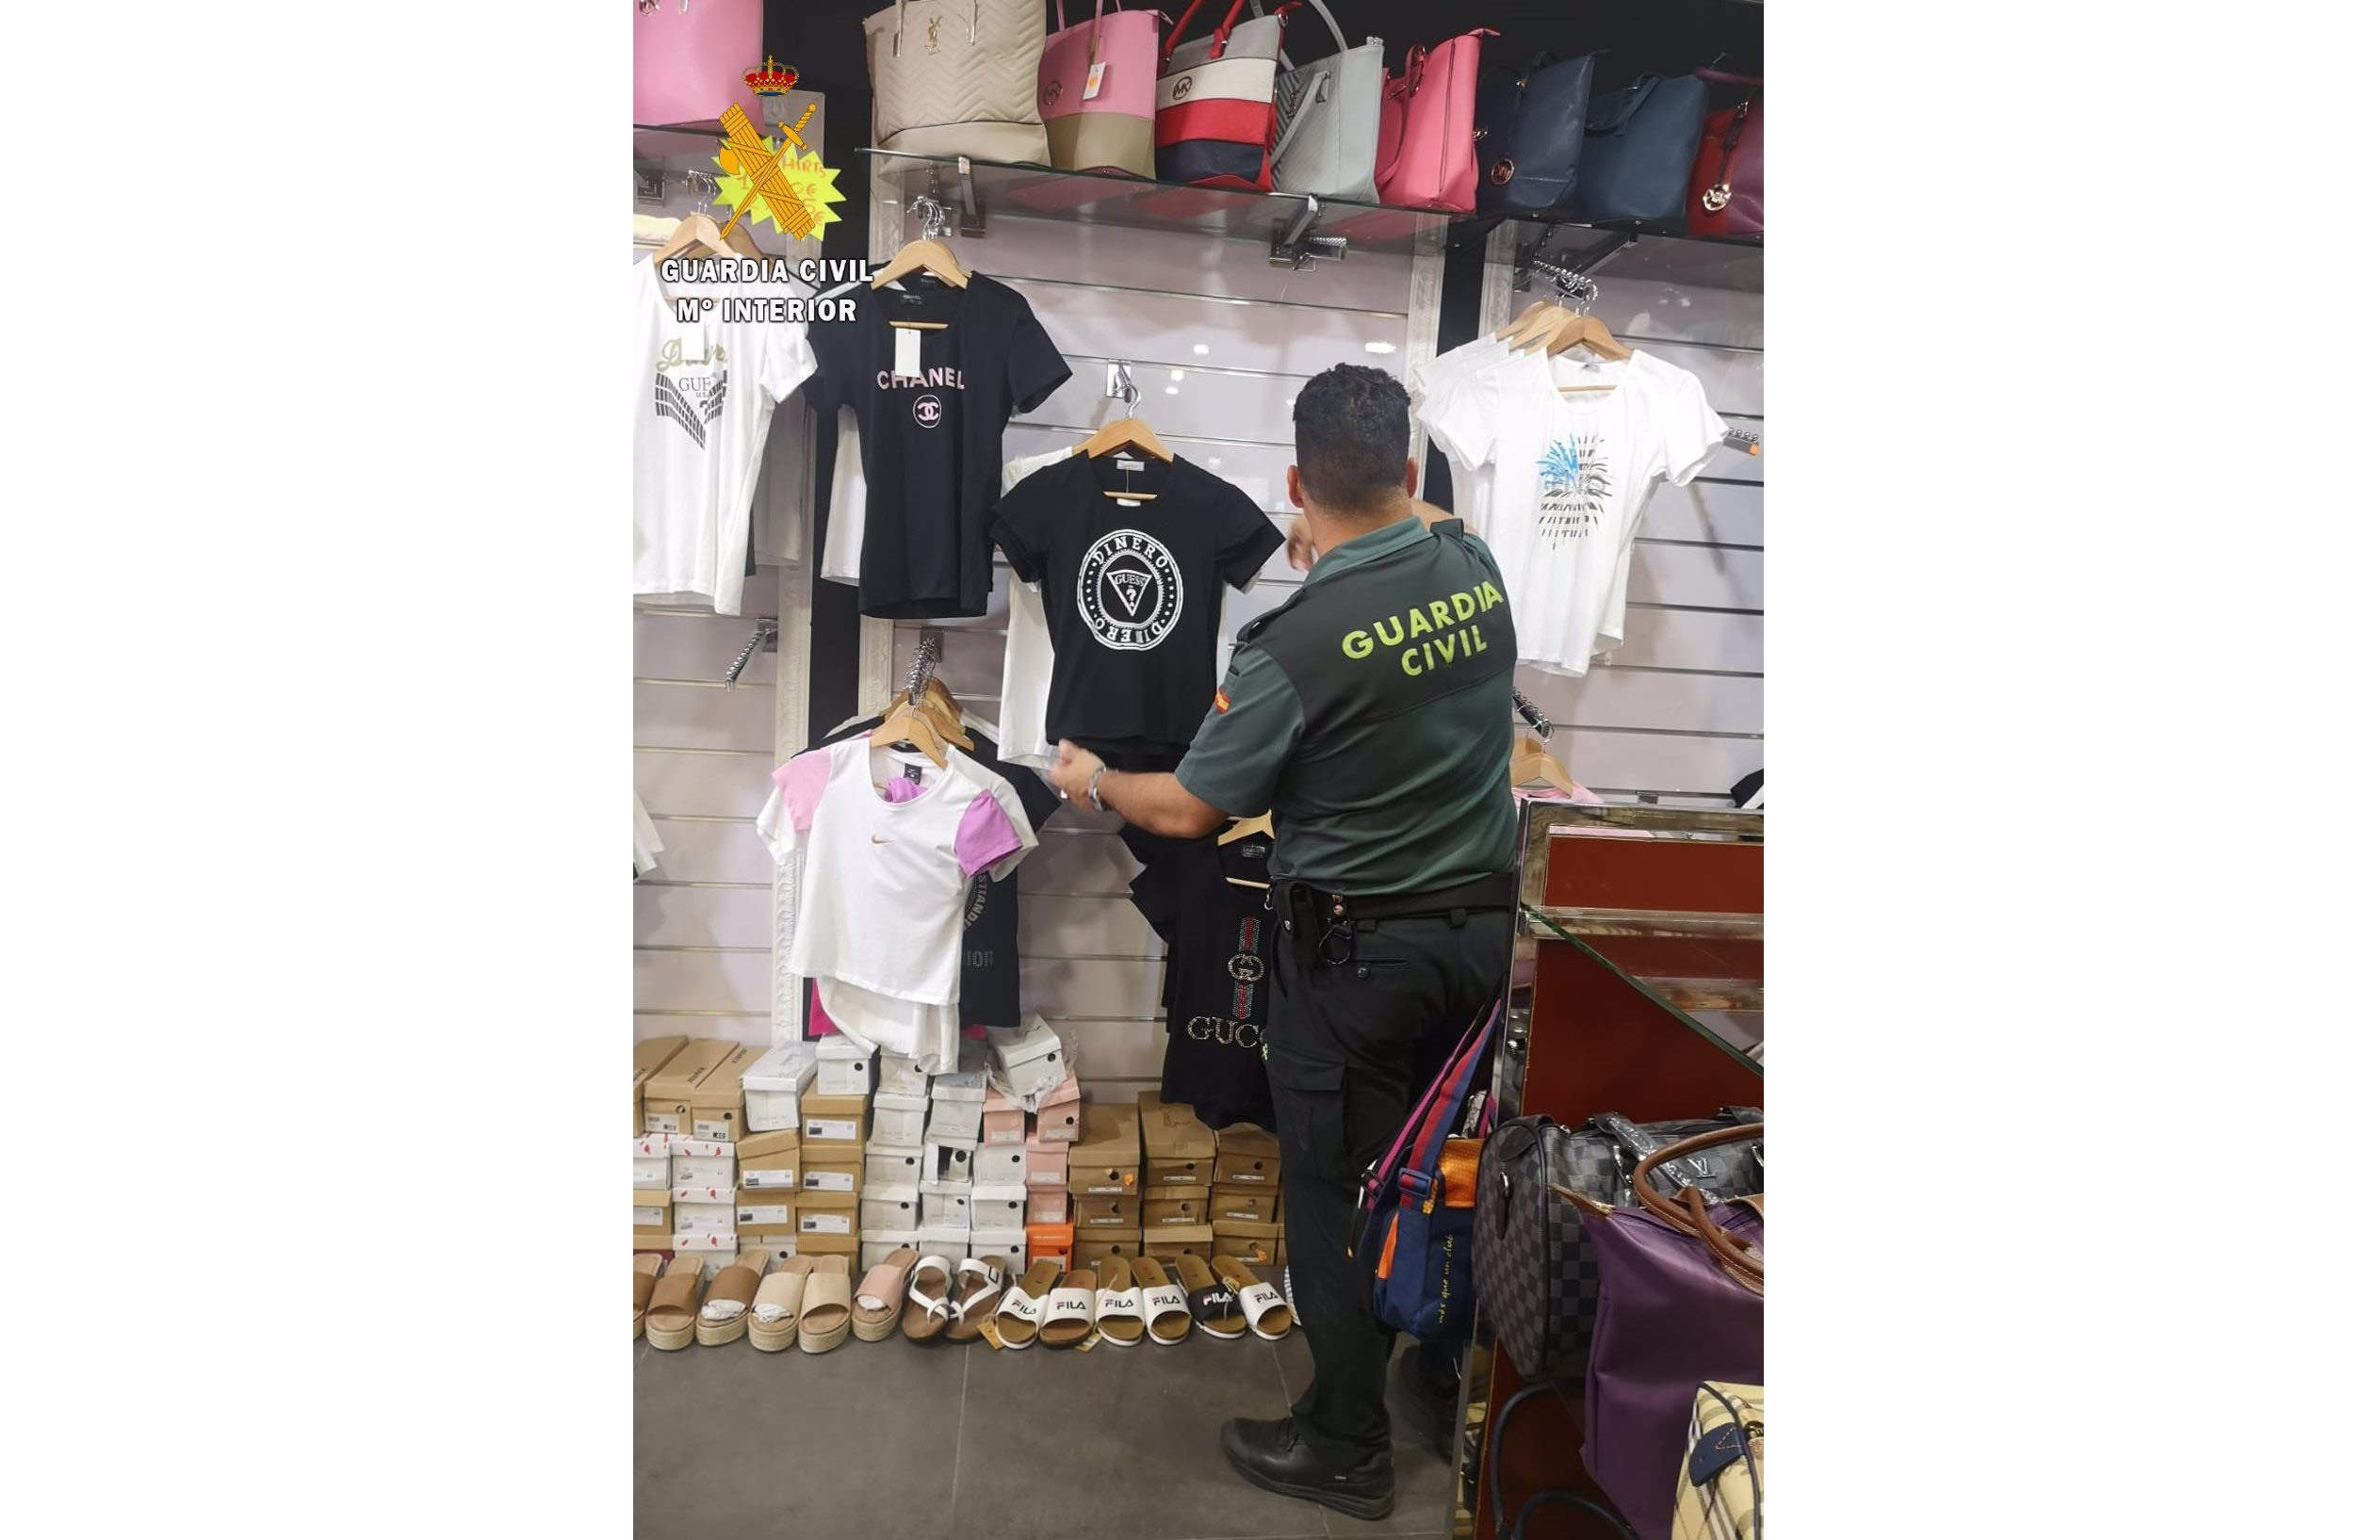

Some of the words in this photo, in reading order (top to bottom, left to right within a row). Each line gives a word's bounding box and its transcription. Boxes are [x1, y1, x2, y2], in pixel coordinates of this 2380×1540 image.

[1093, 536, 1168, 568] DINERO
[1115, 574, 1148, 588] GUESS
[1342, 581, 1504, 659] GUARDIA
[1095, 618, 1165, 644] DINERO
[1401, 624, 1488, 676] CIVIL
[1105, 1299, 1134, 1308] FILA
[1151, 1295, 1181, 1306] FILA
[1202, 1291, 1232, 1306] FILA
[1253, 1289, 1279, 1305] FILA
[1012, 1299, 1037, 1315] FILA
[1056, 1301, 1086, 1310] FILA
